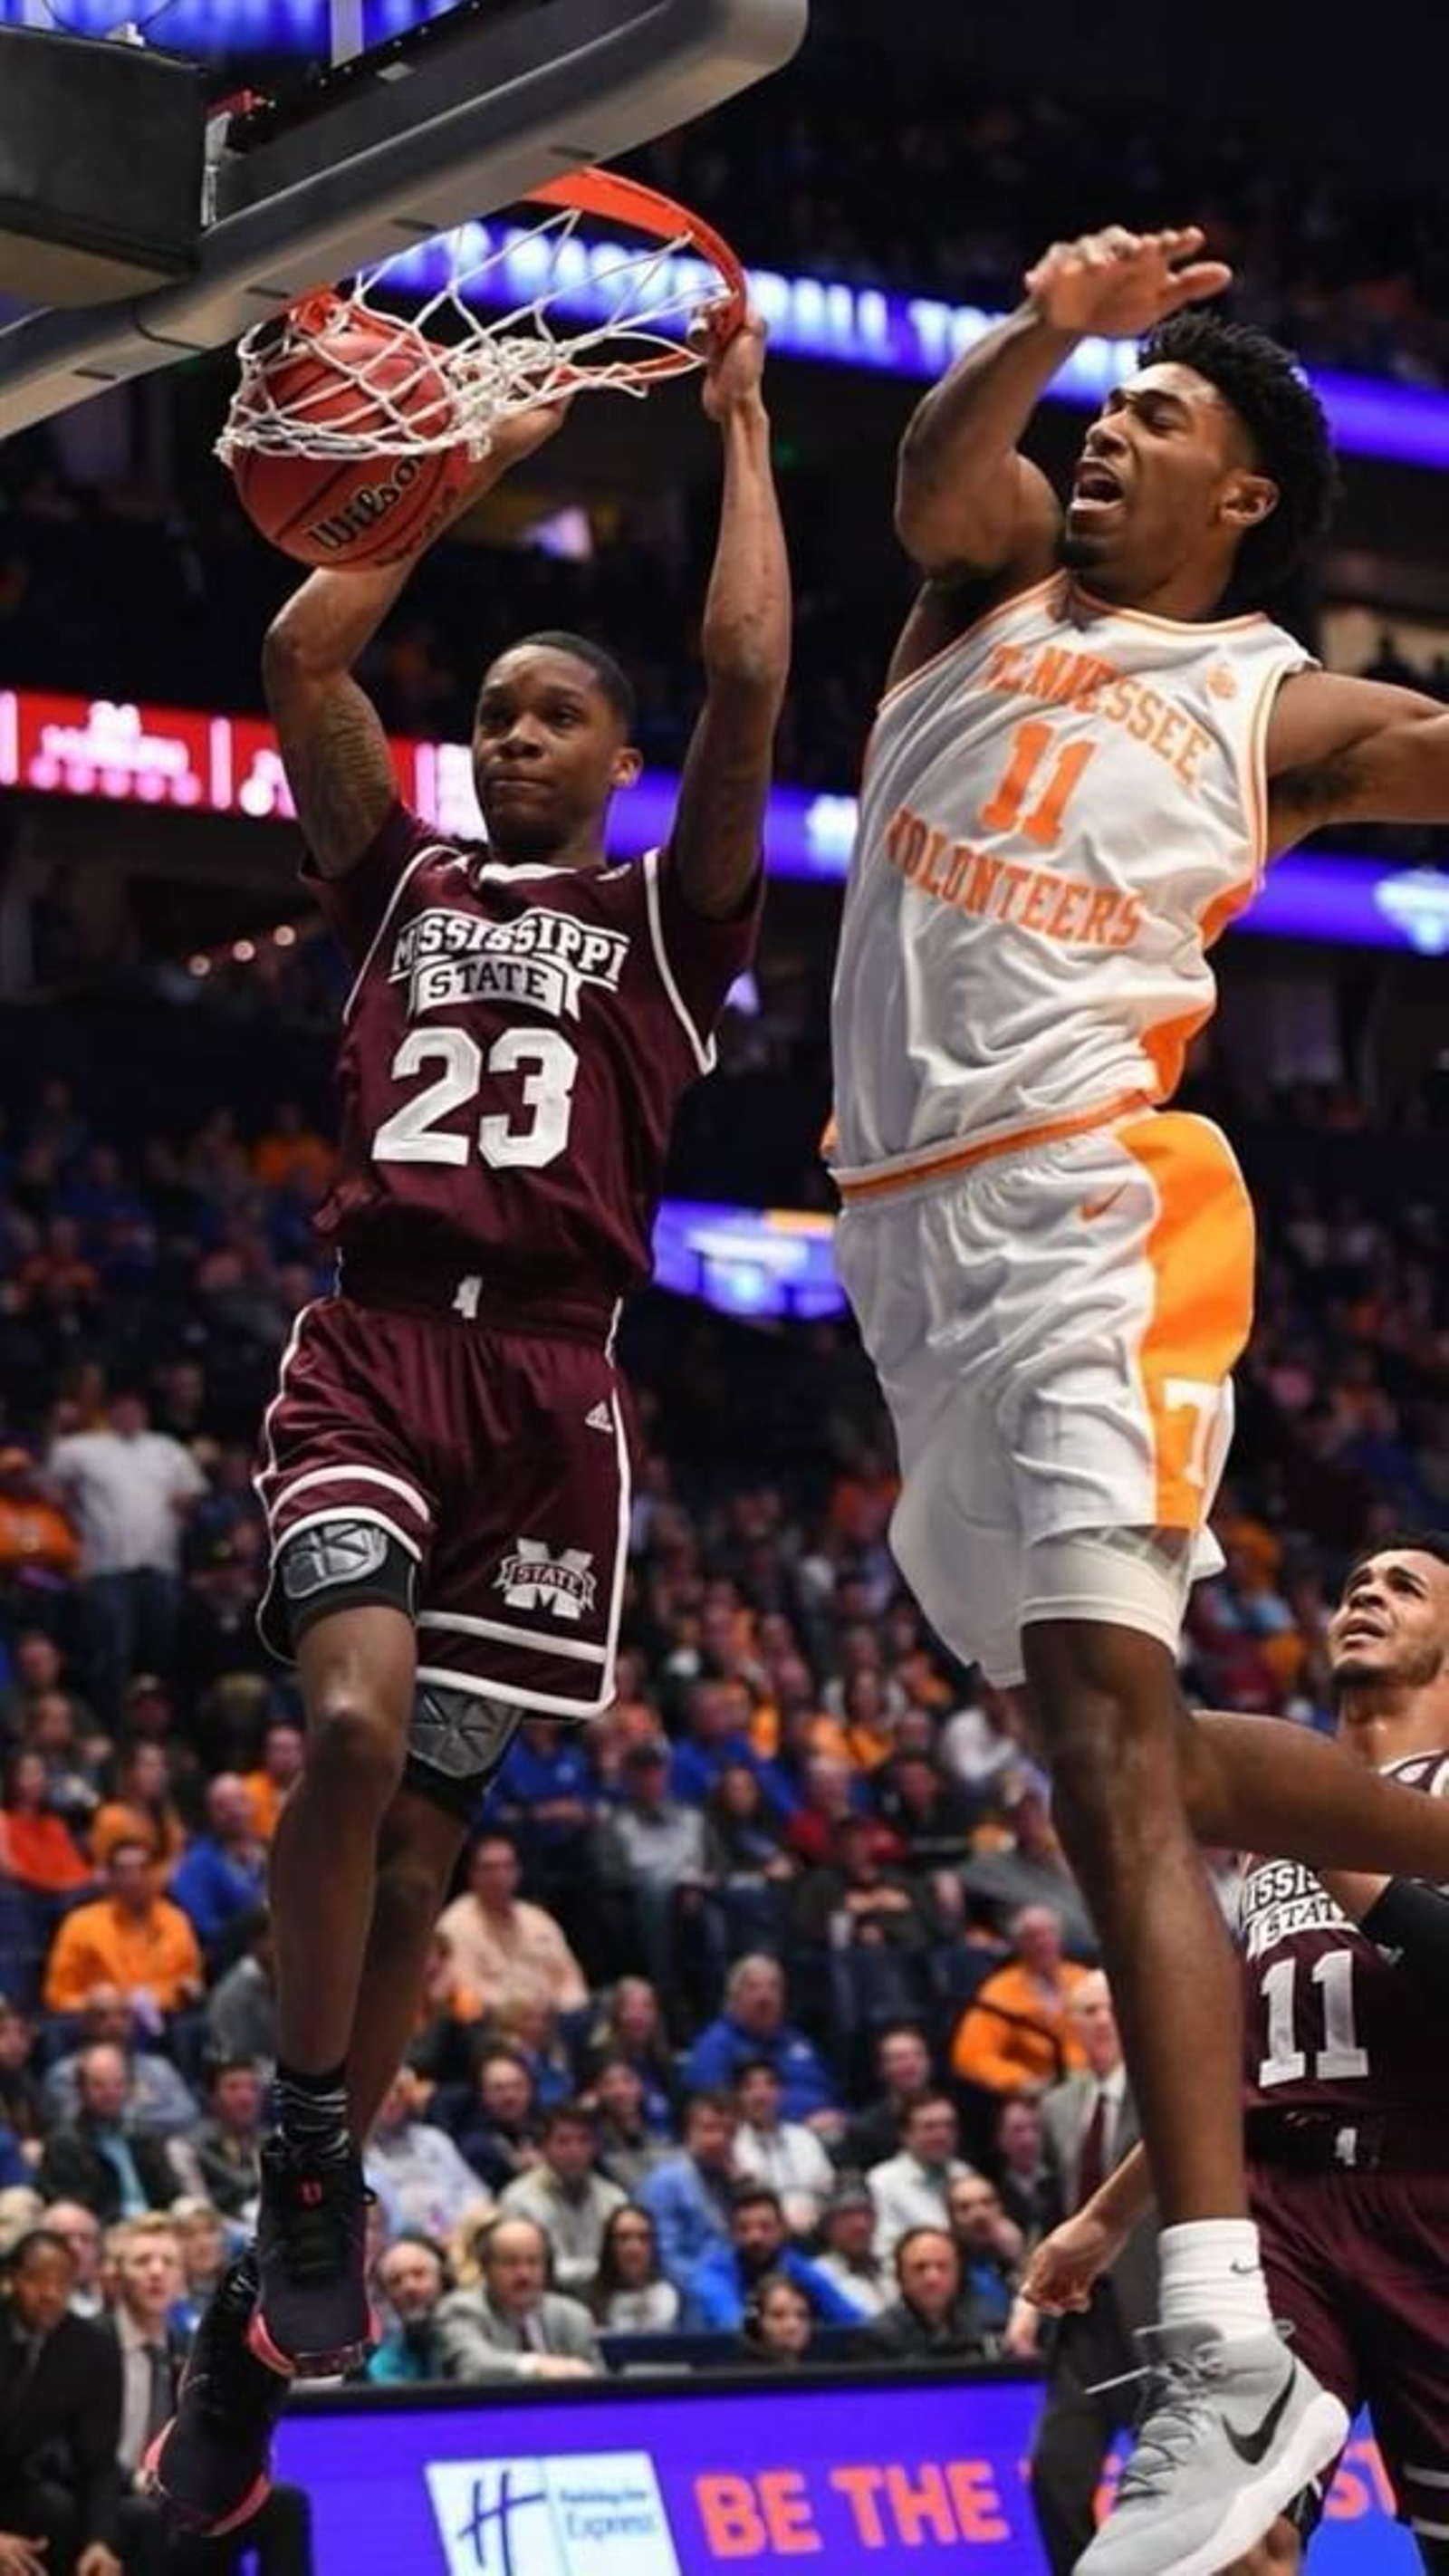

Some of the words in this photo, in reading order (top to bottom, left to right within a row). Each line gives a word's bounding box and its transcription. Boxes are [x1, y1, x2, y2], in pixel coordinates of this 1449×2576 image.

[981, 720, 1099, 846] 11
[427, 961, 547, 1001] STATE
[371, 1026, 579, 1168] 23
[515, 1565, 580, 1596] STATE
[1258, 1949, 1369, 2089] 11
[695, 2470, 823, 2558] BE
[829, 2460, 1011, 2548] THE
